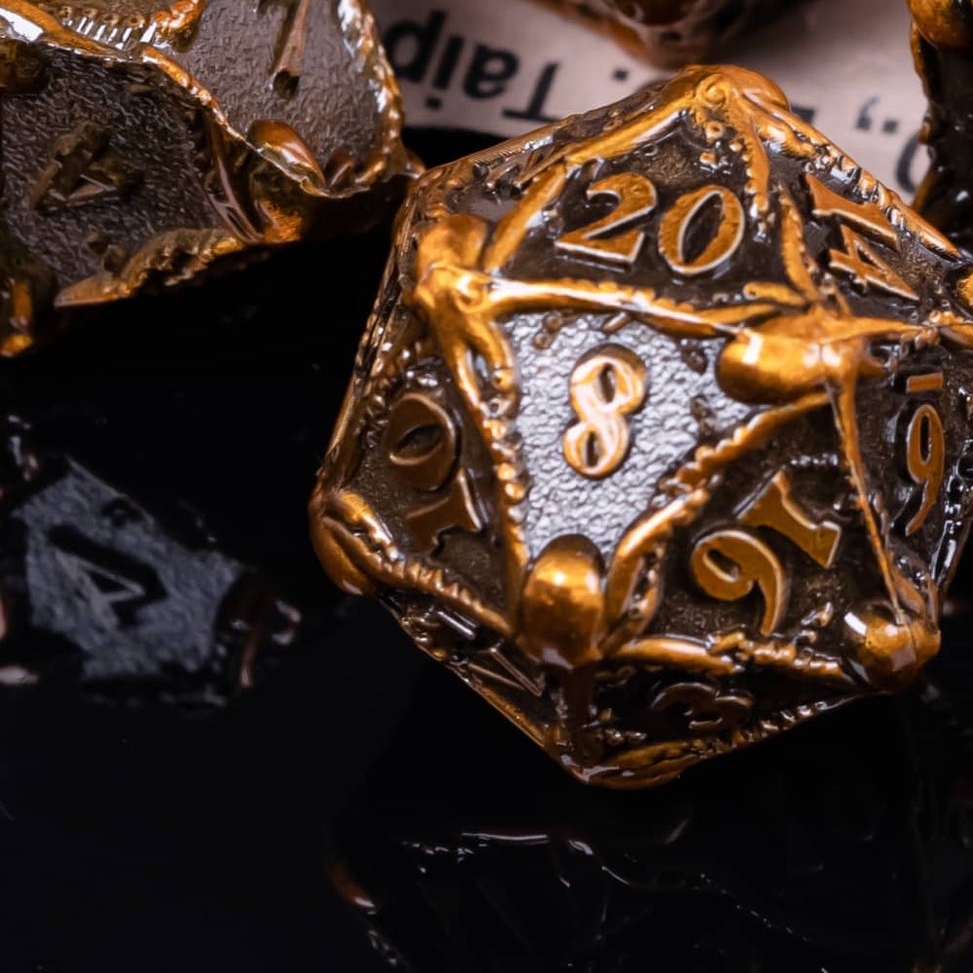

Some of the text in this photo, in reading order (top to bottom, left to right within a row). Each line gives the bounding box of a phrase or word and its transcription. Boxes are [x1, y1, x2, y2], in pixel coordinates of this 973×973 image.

[555, 171, 747, 277] 20
[561, 341, 650, 479] 8
[689, 468, 843, 638] 16
